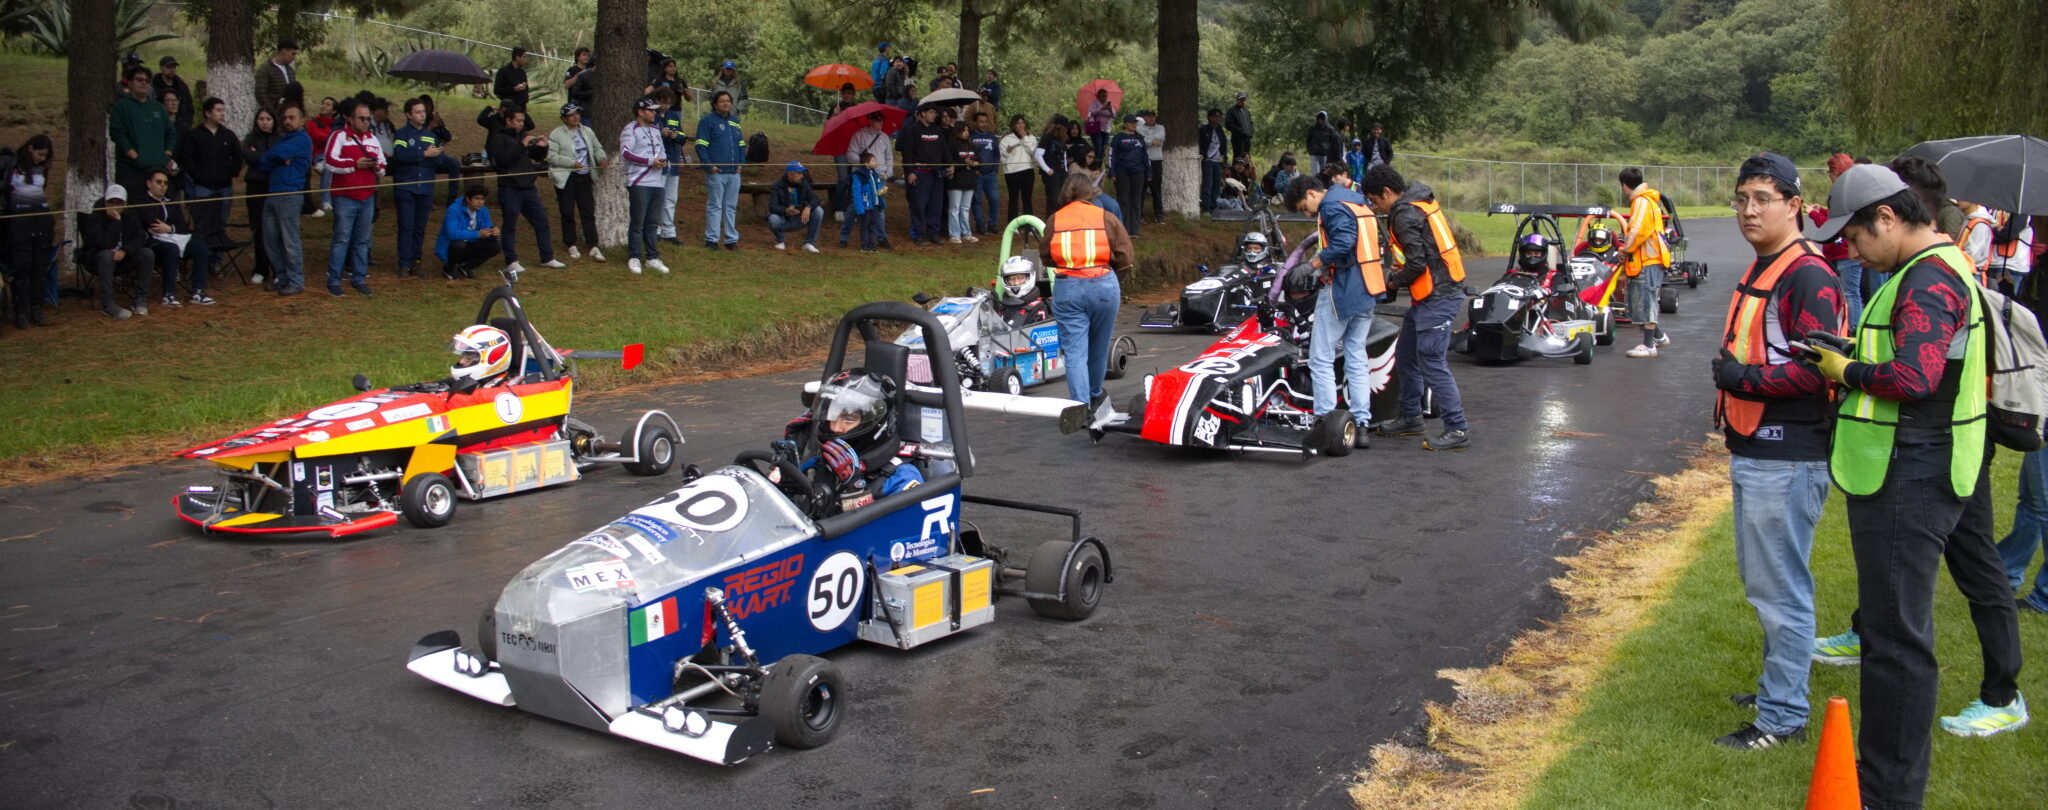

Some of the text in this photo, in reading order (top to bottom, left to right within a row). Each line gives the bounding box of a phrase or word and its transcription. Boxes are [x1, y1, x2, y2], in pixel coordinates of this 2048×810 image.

[505, 399, 514, 416] 1
[905, 545, 938, 558] de Monterrey
[573, 568, 629, 588] MEX
[722, 553, 805, 600] REGIO
[726, 579, 796, 620] KART
[811, 567, 858, 619] 50
[501, 631, 517, 646] TEC
